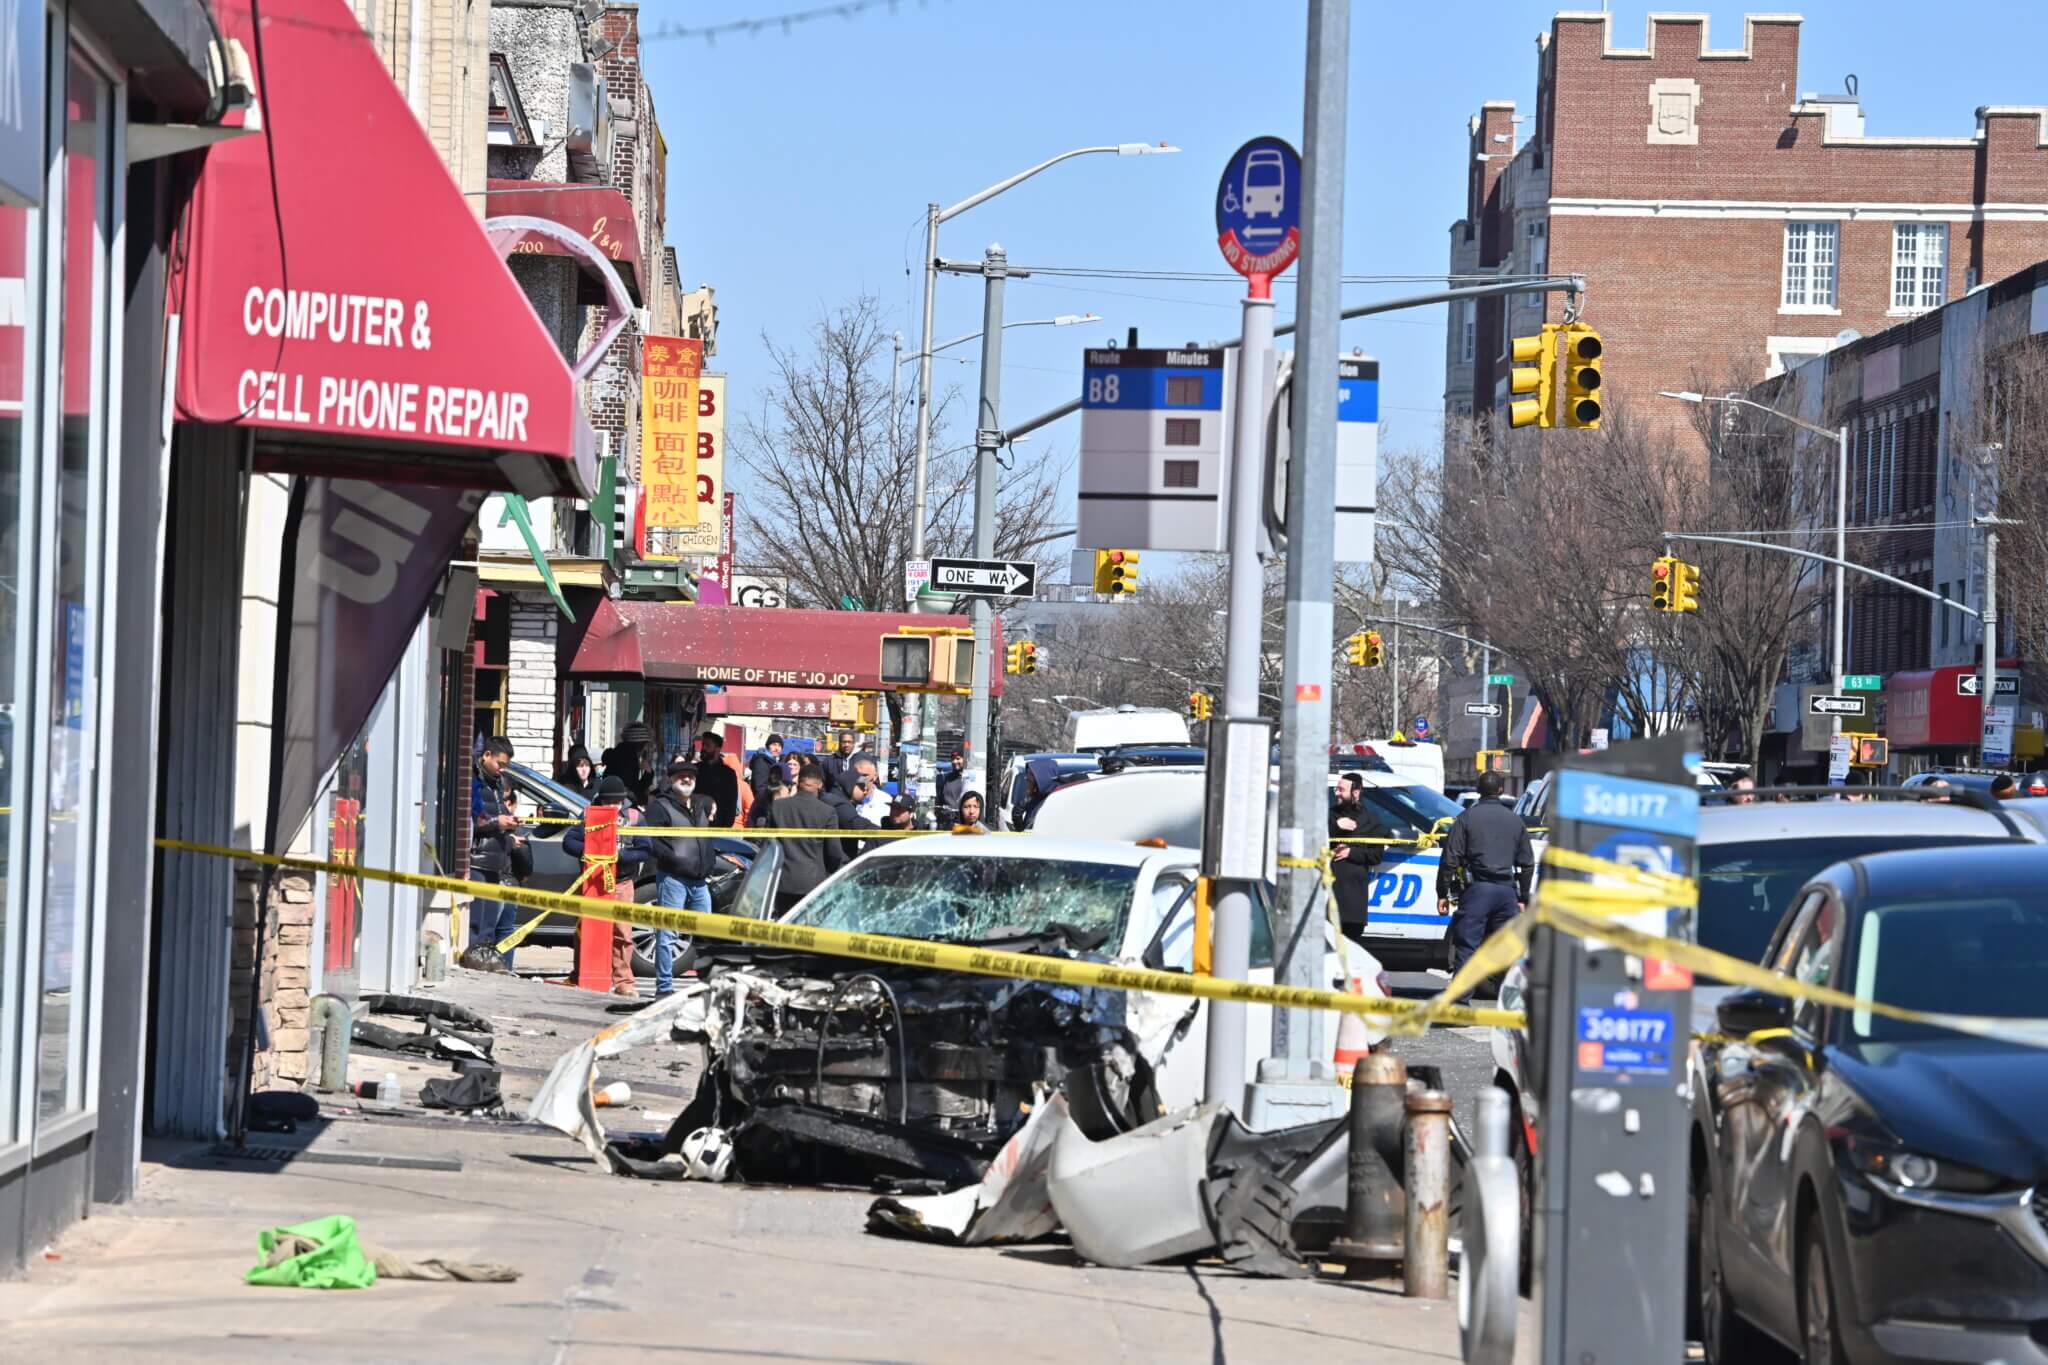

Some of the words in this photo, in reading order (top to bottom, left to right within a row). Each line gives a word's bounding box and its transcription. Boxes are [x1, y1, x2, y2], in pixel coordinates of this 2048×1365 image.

[1223, 240, 1240, 263] NO
[1240, 237, 1297, 272] STANDING
[243, 286, 404, 347] COMPUTER
[411, 300, 431, 350] &
[1090, 350, 1120, 365] Route
[1166, 351, 1209, 366] Minutes
[1088, 373, 1120, 403] B8
[238, 369, 311, 423] CELL
[318, 376, 419, 432] PHONE
[424, 385, 529, 442] REPAIR
[682, 535, 718, 546] CHICKEN
[721, 561, 730, 589] EYES
[945, 569, 975, 583] ONE
[988, 572, 1019, 585] WAY
[697, 667, 741, 680] HOME
[744, 669, 765, 681] OF
[768, 670, 797, 683] THE
[801, 672, 826, 685] "JO
[1851, 677, 1862, 688] 63
[1819, 701, 1832, 709] ONE
[1367, 872, 1423, 908] PD
[1585, 1016, 1667, 1042] 308177
